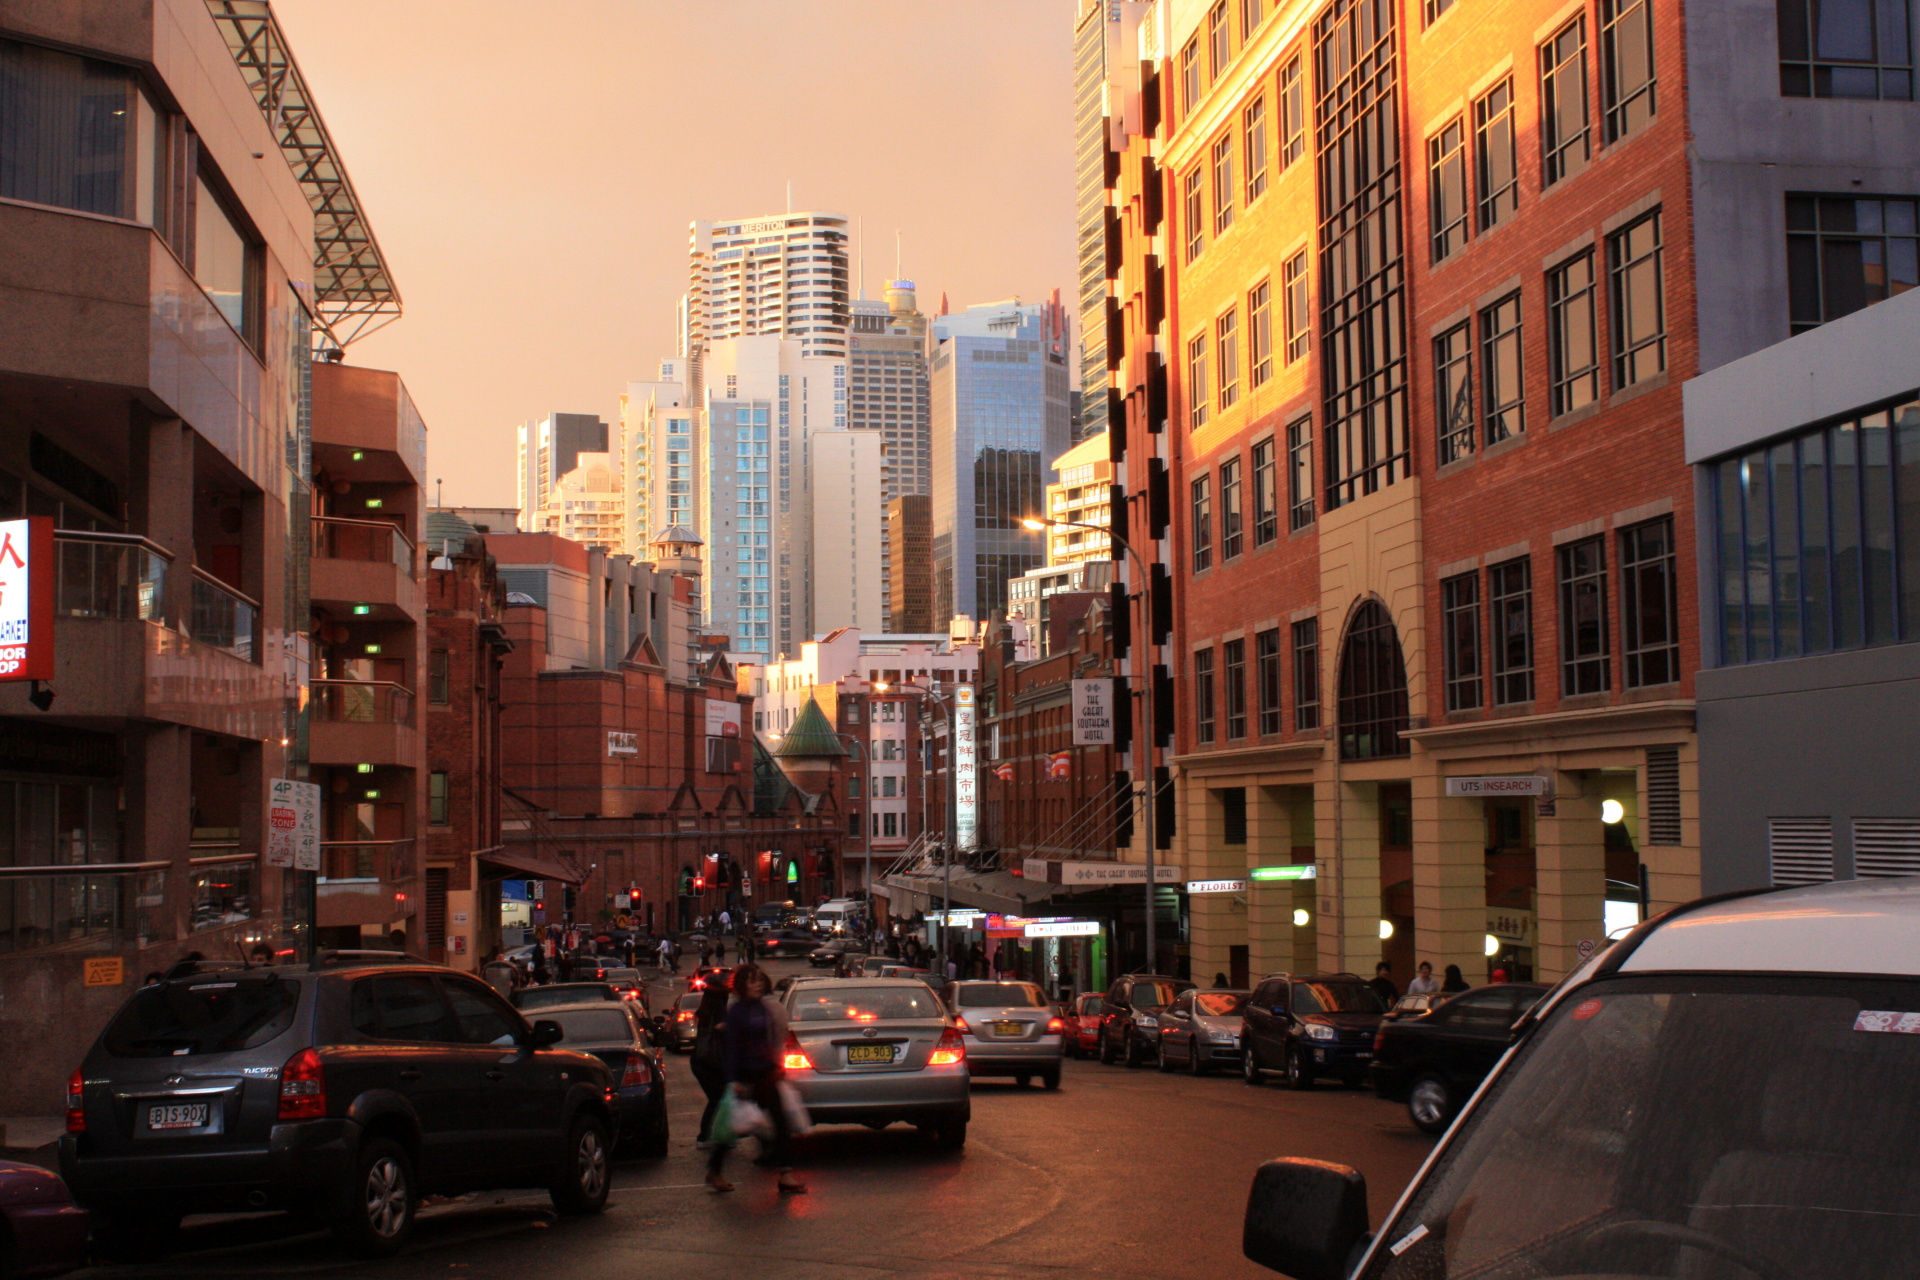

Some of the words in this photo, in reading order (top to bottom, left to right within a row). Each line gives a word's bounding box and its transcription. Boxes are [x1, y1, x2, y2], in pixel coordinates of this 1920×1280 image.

[741, 220, 785, 234] MERITON
[1087, 695, 1099, 705] THE
[1082, 706, 1103, 716] GREAT
[1077, 718, 1109, 728] SOUTHERN
[1084, 730, 1104, 740] HOTEL
[274, 783, 292, 793] 4P
[272, 809, 295, 818] LOADING
[272, 818, 296, 828] ZONE
[1097, 869, 1106, 879] THE
[1109, 870, 1126, 878] GREAT
[1128, 870, 1149, 878] SOUTHE
[1156, 869, 1173, 878] HOTEL
[1200, 882, 1244, 891] FLORIST
[850, 1047, 870, 1058] ZCD
[873, 1046, 891, 1057] 903
